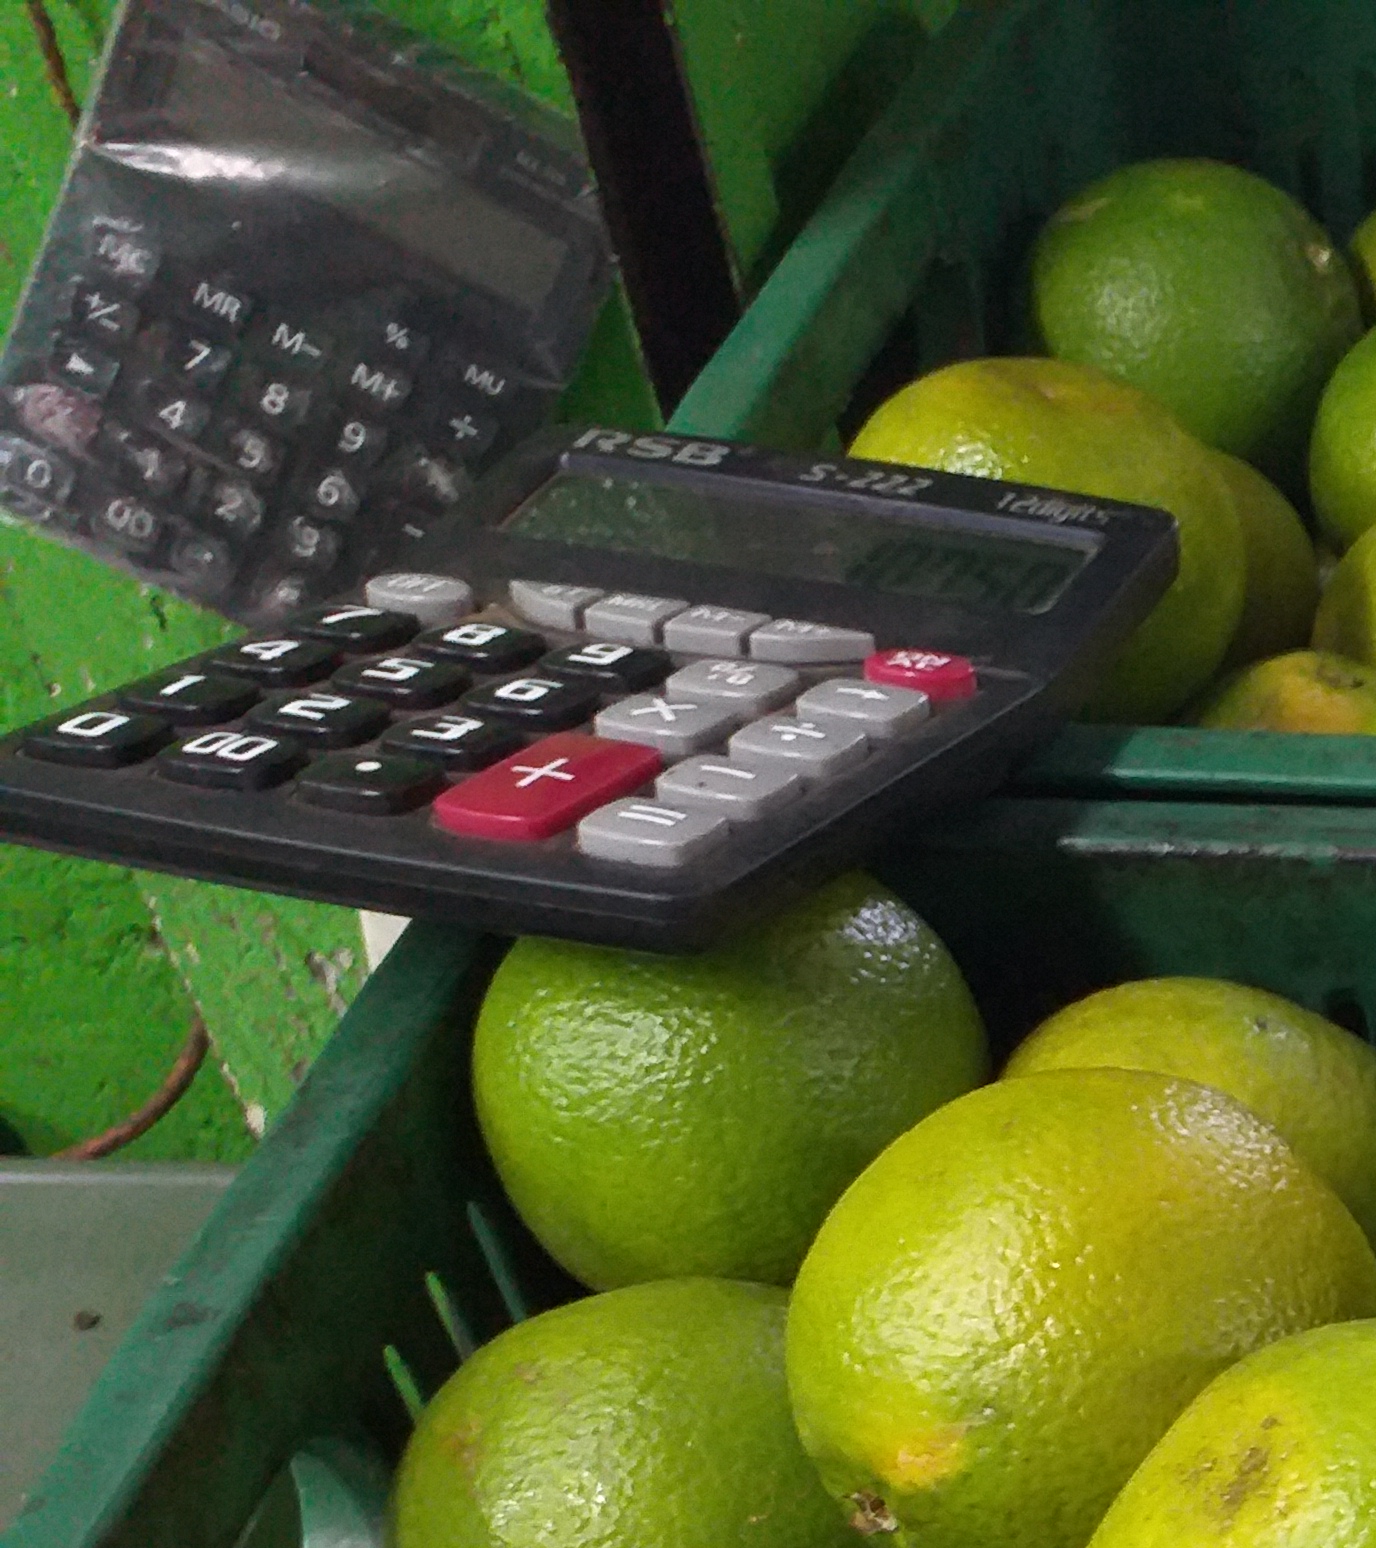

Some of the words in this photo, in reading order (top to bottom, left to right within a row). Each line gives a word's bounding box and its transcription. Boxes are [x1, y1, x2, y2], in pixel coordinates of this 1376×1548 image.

[194, 282, 242, 323] MR
[186, 339, 212, 370] 7
[464, 364, 506, 396] MU
[261, 383, 289, 415] 8
[159, 400, 187, 430] 4
[338, 421, 367, 453] 9
[573, 428, 732, 467] RSB
[27, 459, 51, 488] 0
[317, 474, 345, 506] 6
[106, 499, 153, 538] 00
[322, 605, 385, 625] 7
[441, 622, 507, 647] 8
[241, 639, 300, 661] 4
[567, 642, 634, 666] 9
[362, 656, 434, 682] 5
[159, 674, 206, 696] 1
[493, 677, 563, 702] 6
[278, 692, 351, 721] 2
[57, 710, 131, 738] 0
[411, 714, 484, 741] 3
[181, 730, 279, 762] 00
